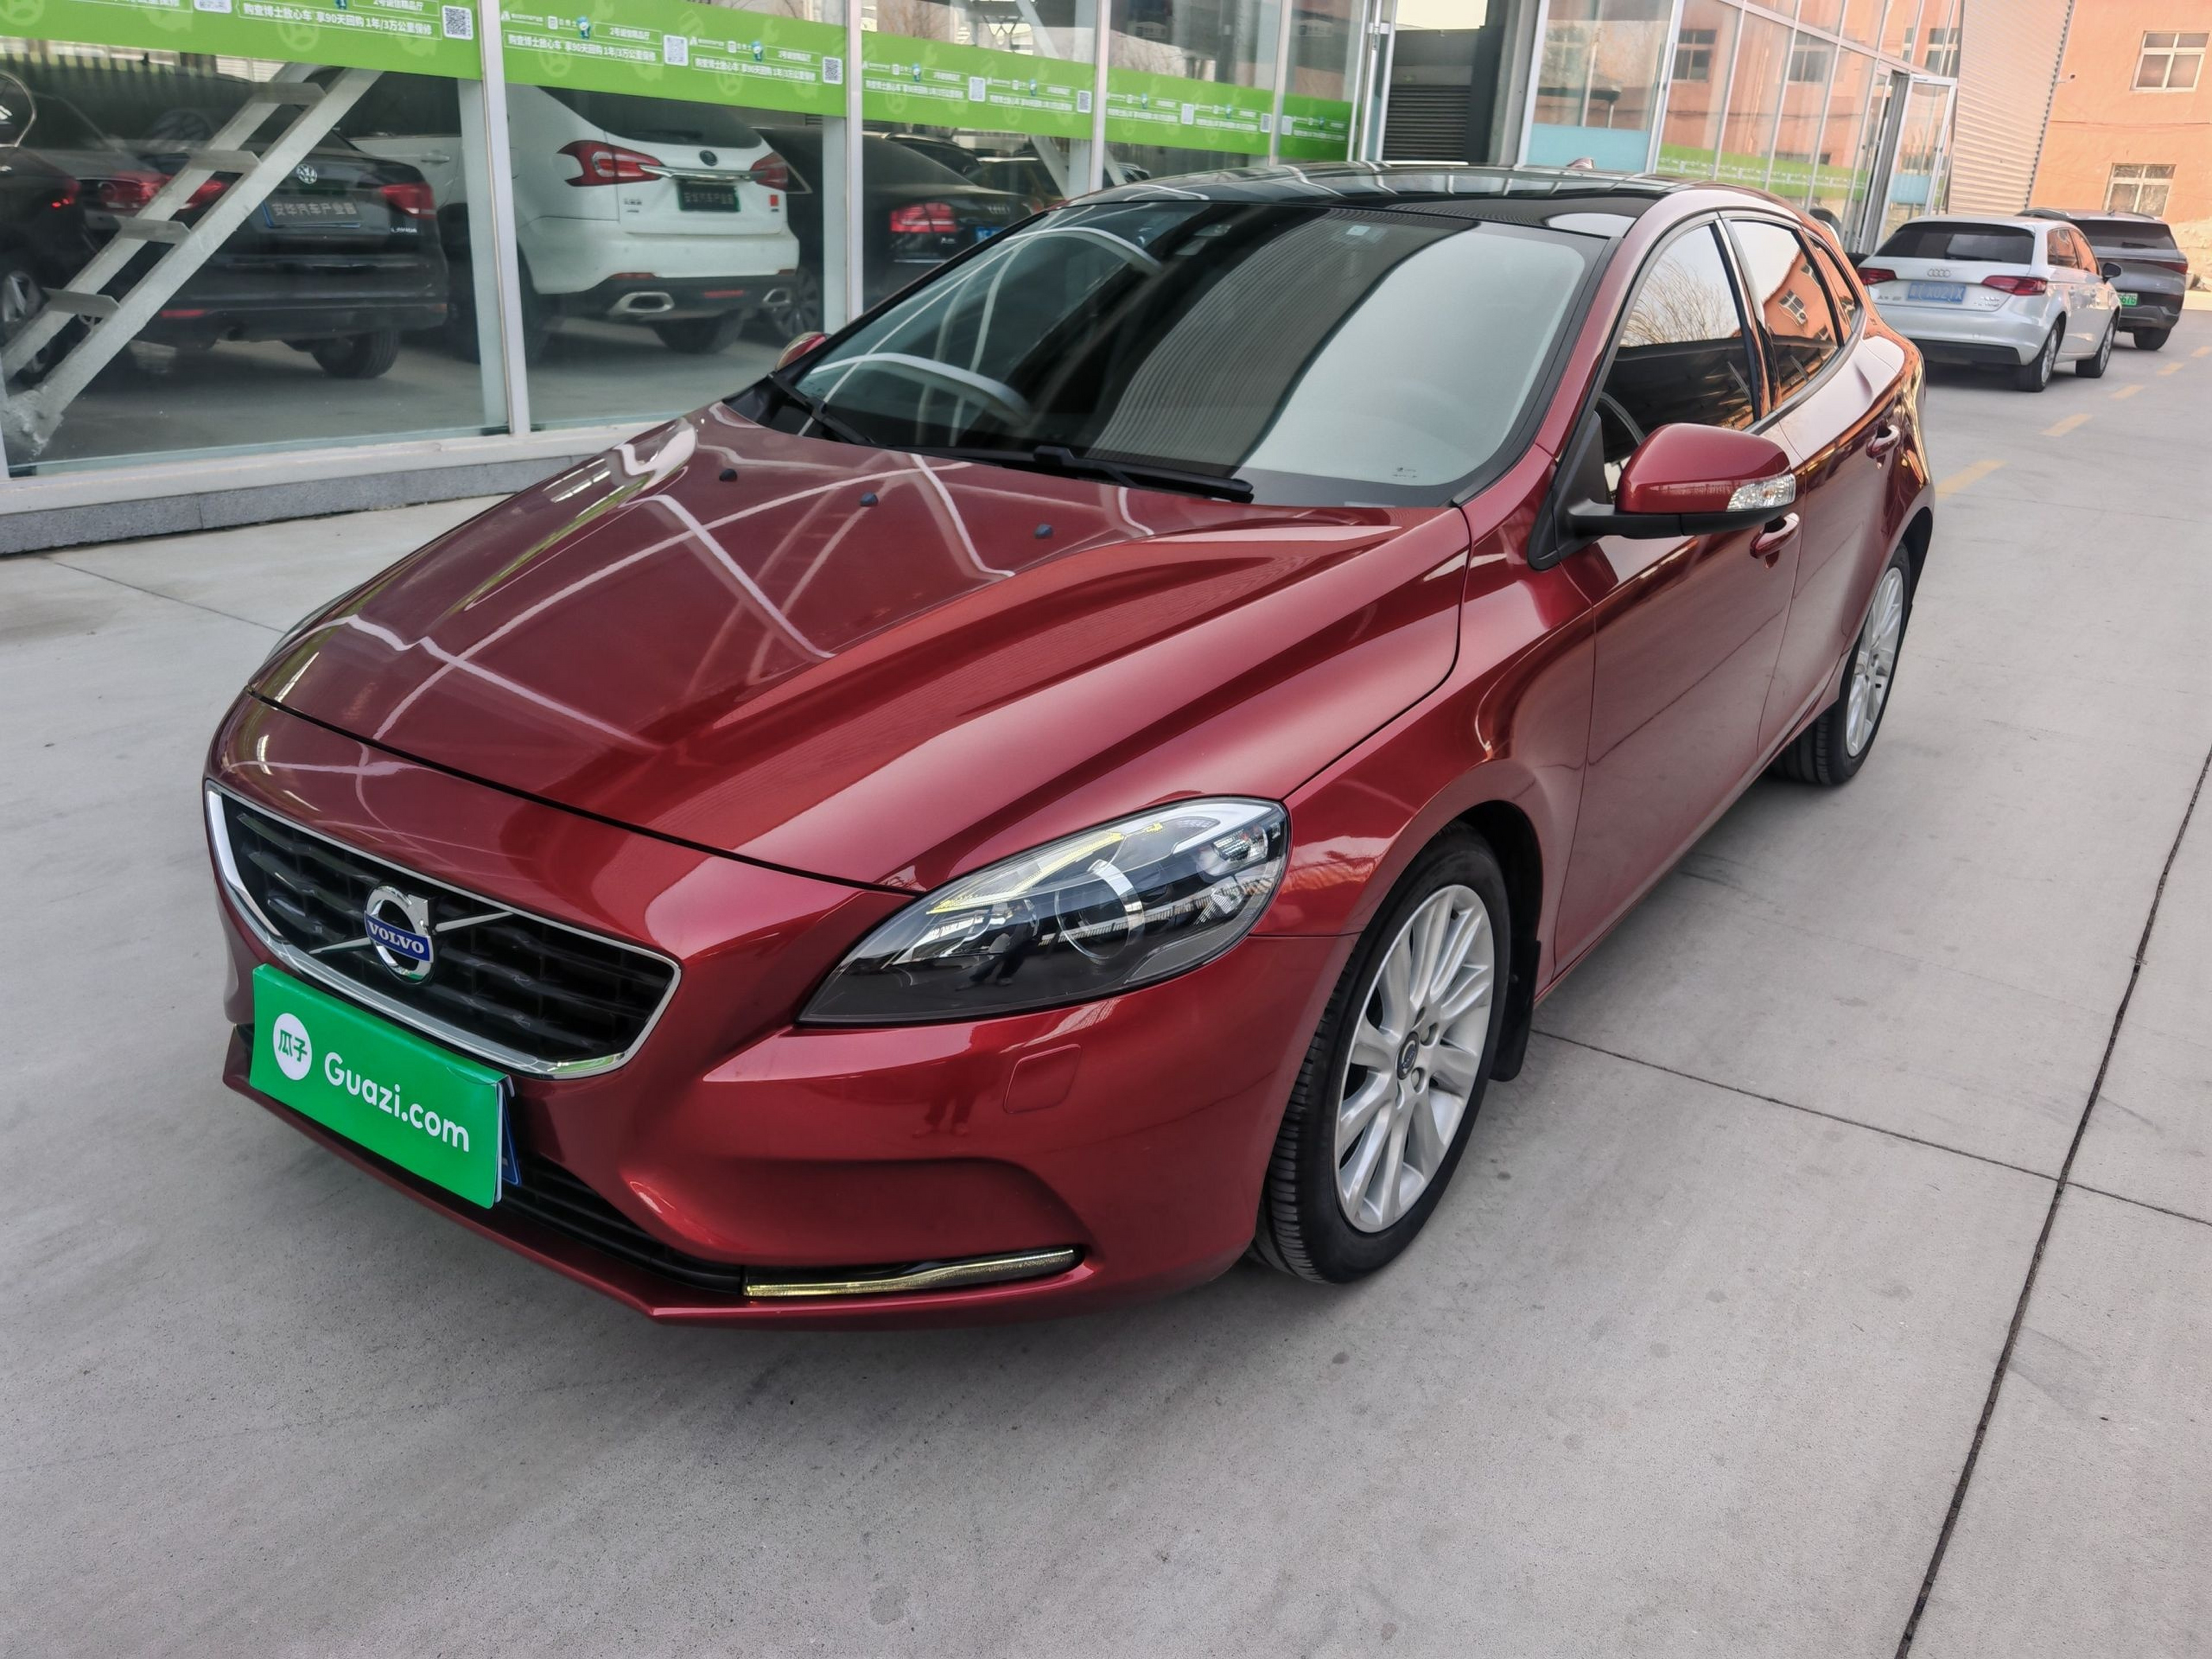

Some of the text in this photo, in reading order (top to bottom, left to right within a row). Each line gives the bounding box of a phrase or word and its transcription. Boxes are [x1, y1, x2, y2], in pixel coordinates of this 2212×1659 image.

[368, 920, 425, 954] VOLVO
[278, 1029, 308, 1062] 瓜子
[324, 1051, 469, 1153] Guazi.com
